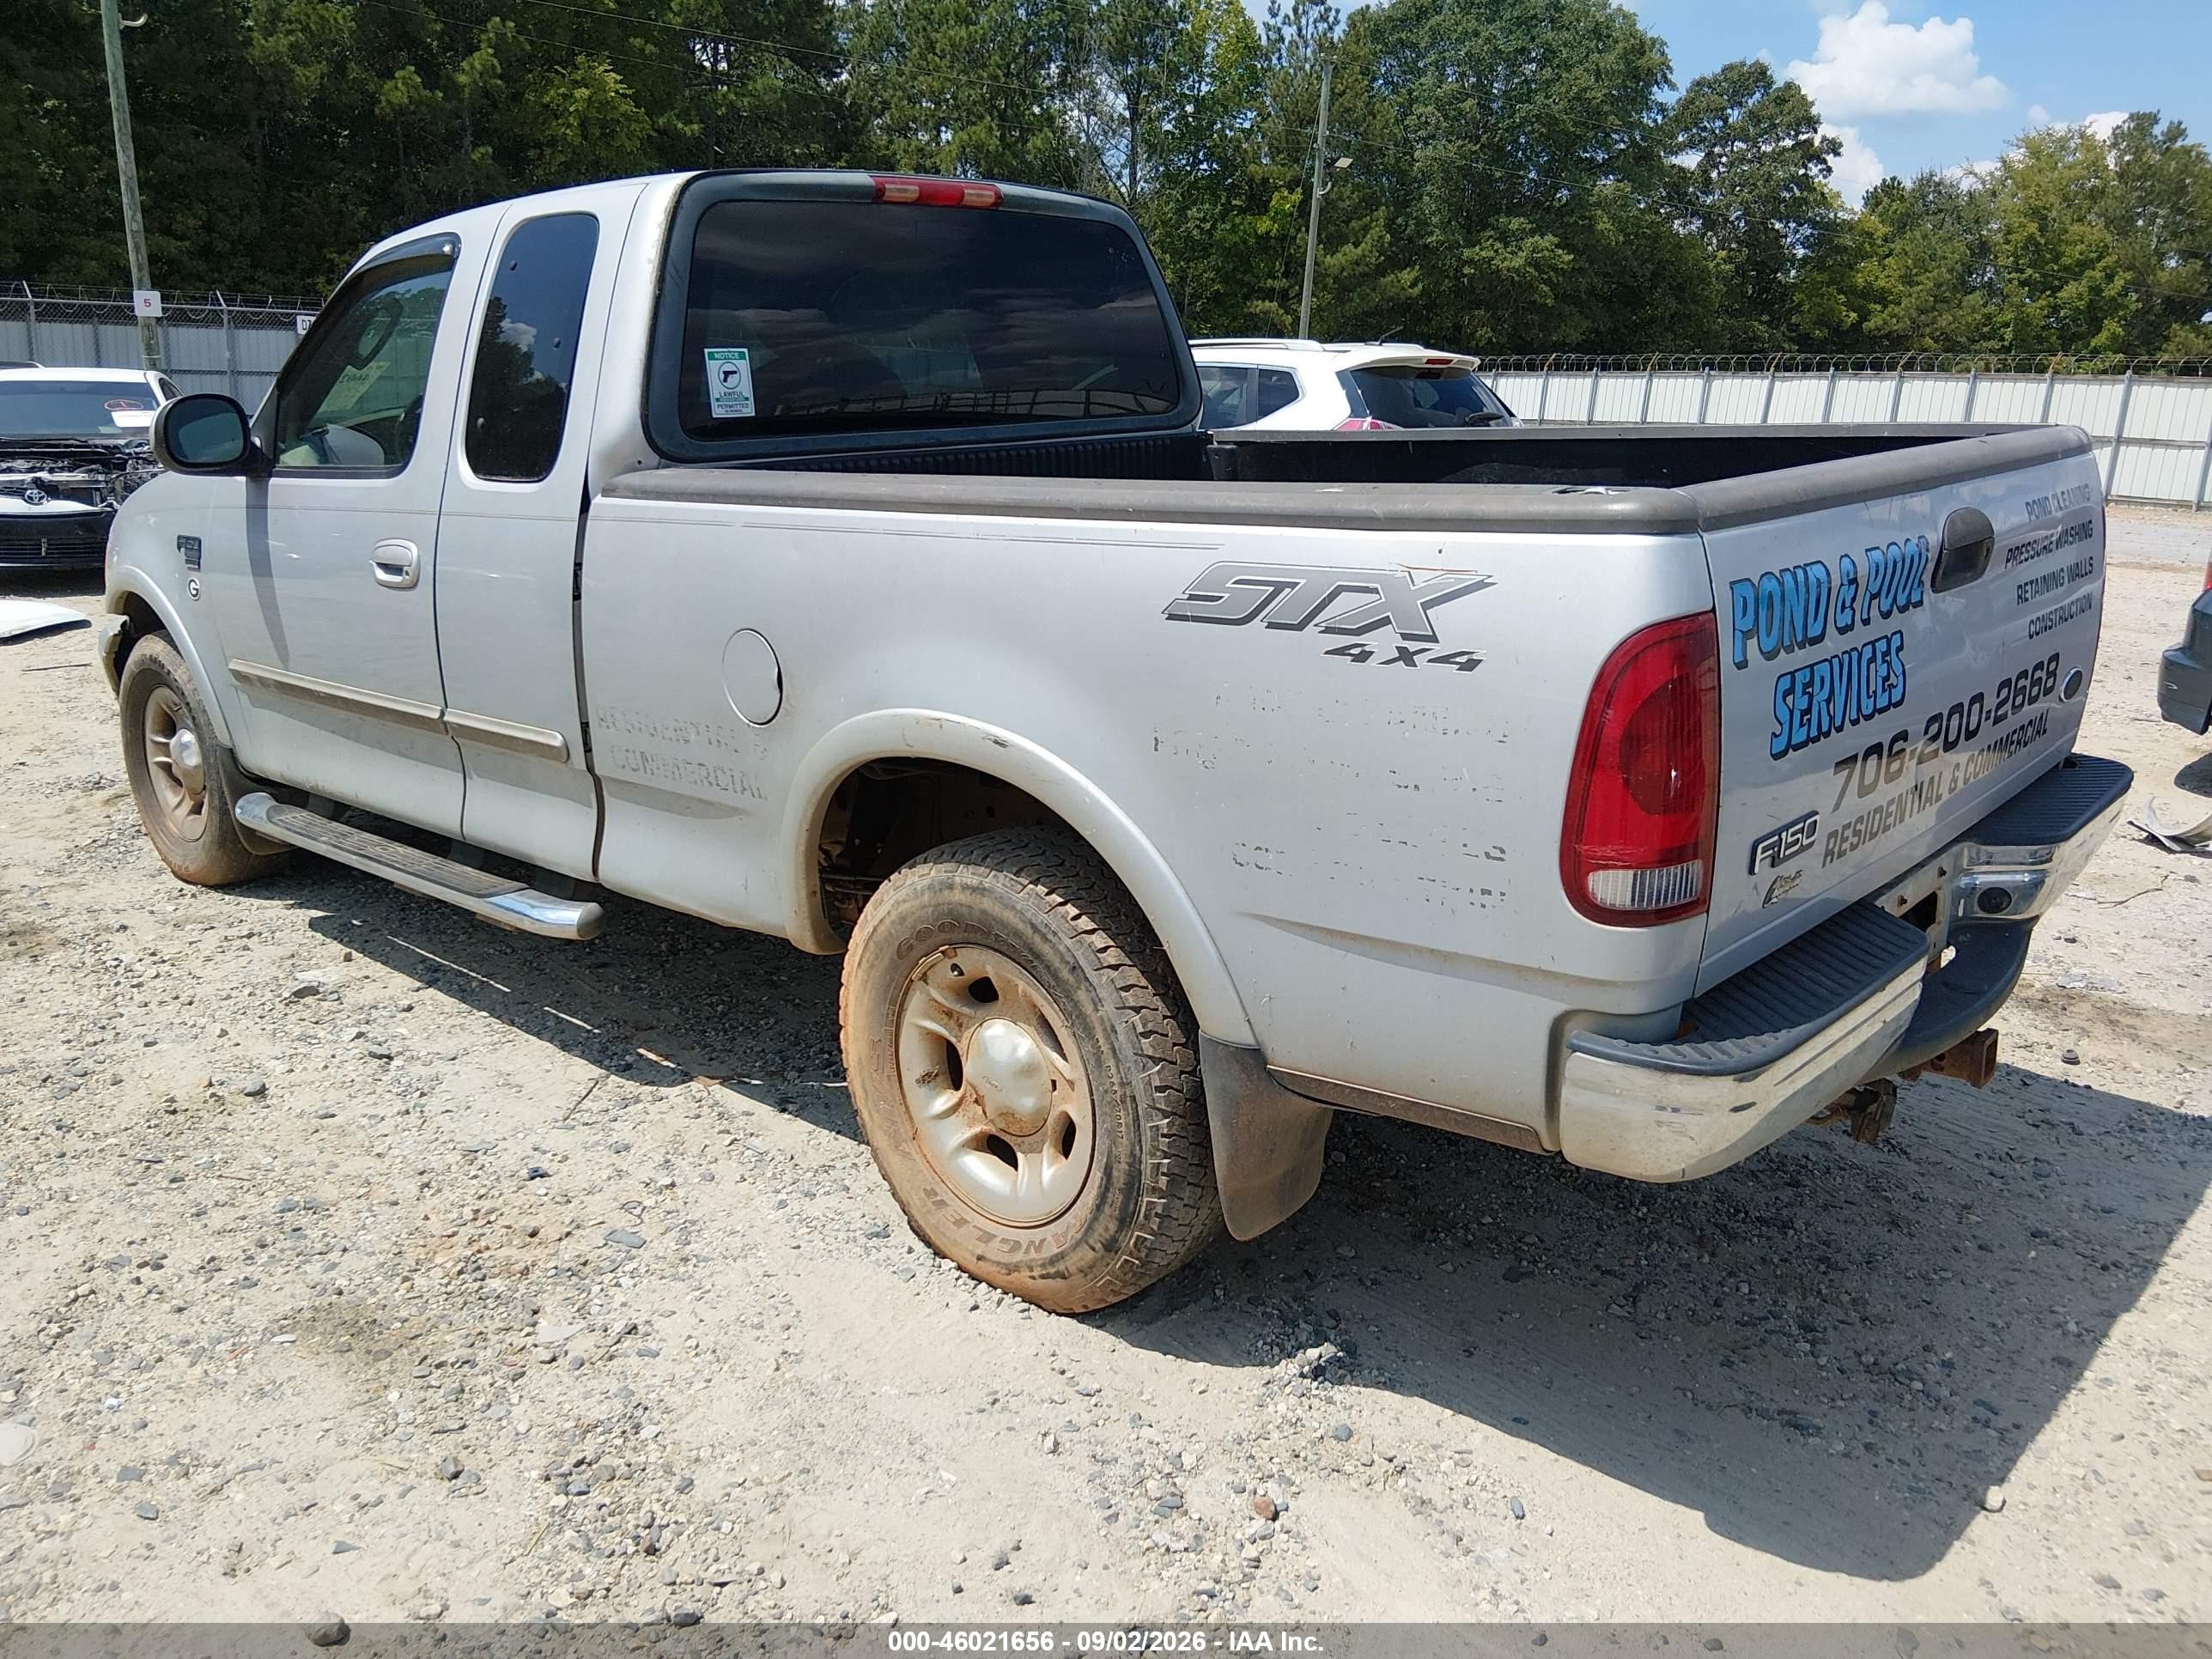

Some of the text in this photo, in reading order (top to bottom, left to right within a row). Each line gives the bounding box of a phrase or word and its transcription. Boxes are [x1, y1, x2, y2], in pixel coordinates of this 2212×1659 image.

[143, 297, 153, 308] 5
[2025, 495, 2053, 523] POND
[2003, 519, 2094, 570] PRESSURE WASHING
[187, 578, 200, 599] G
[1162, 561, 1498, 643] STX
[1729, 535, 1930, 671] POND & POOL
[2016, 556, 2094, 606] RETAINING WALLS
[2027, 590, 2094, 641] CONSTRUCTION
[1769, 630, 1906, 761] SERVICES
[1832, 652, 2060, 814] 706-200-2668
[1821, 708, 2049, 869] RESIDENTIAL & COMMERCIAL
